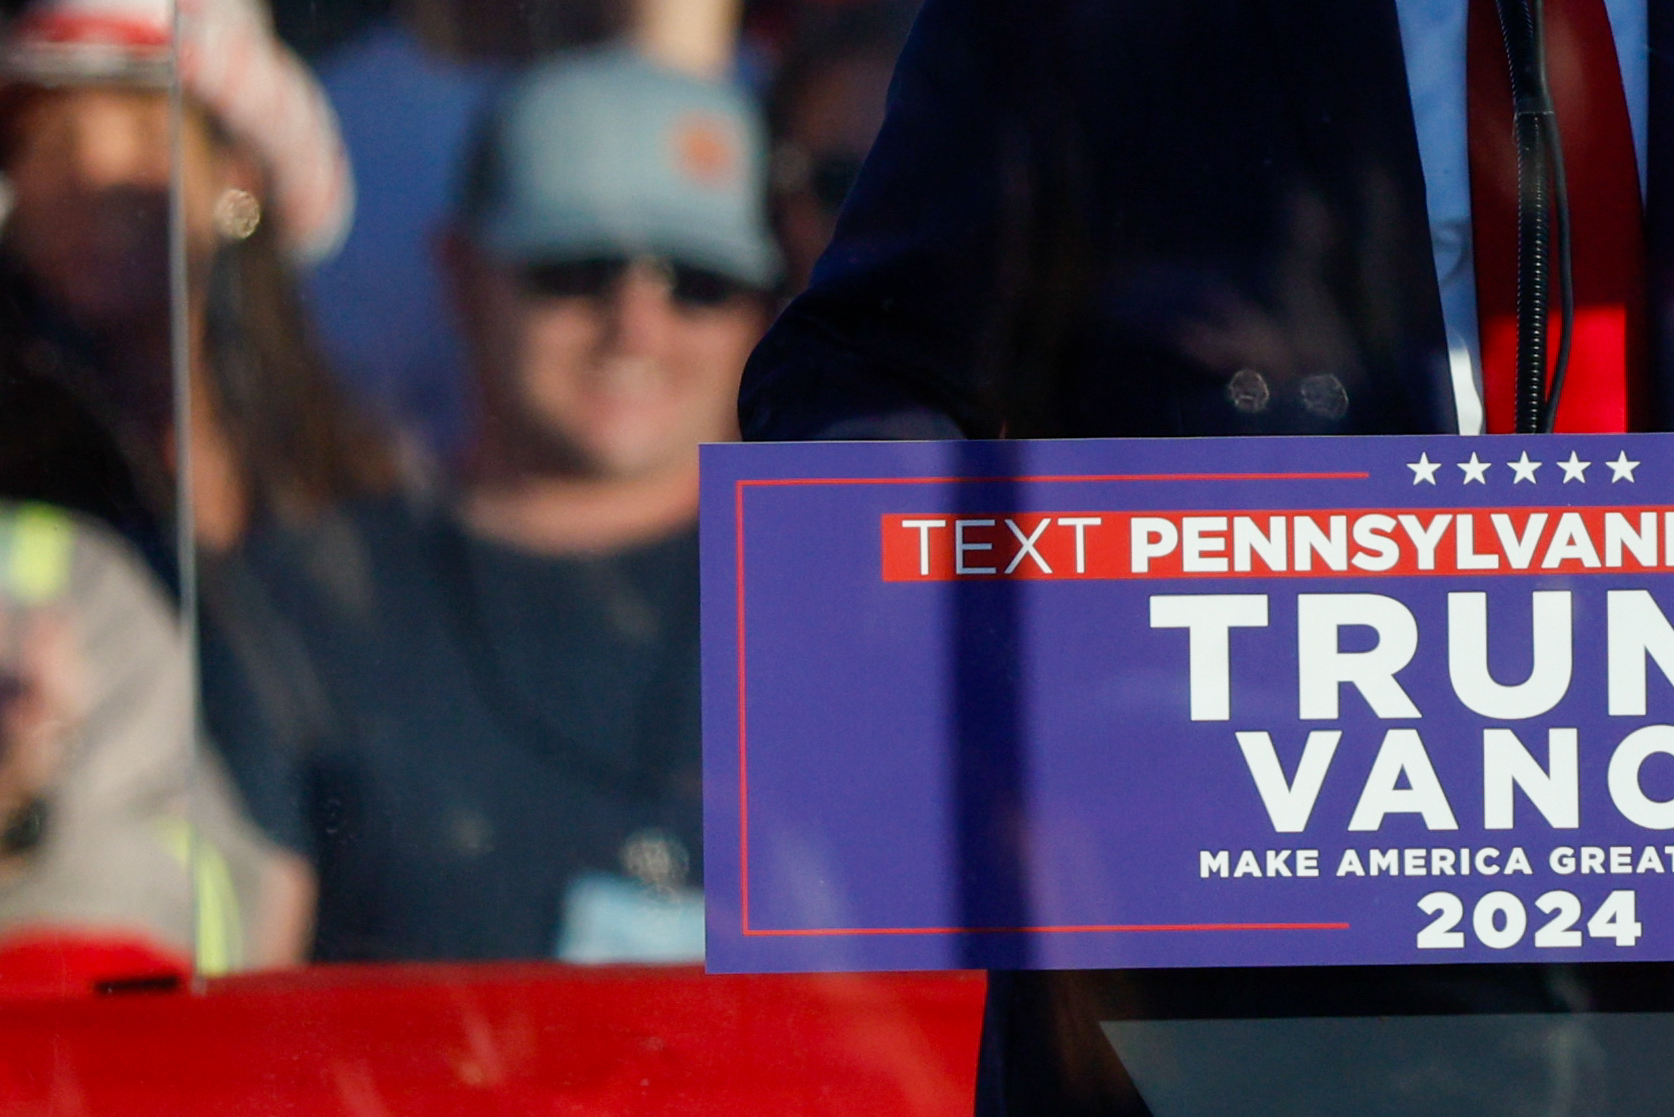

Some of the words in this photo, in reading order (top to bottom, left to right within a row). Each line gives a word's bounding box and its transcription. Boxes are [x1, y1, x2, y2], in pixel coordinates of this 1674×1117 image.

[901, 516, 1102, 576] TEXT
[1199, 848, 1321, 879] MAKE
[1335, 845, 1534, 878] AMERICA
[1416, 889, 1643, 950] 2024
